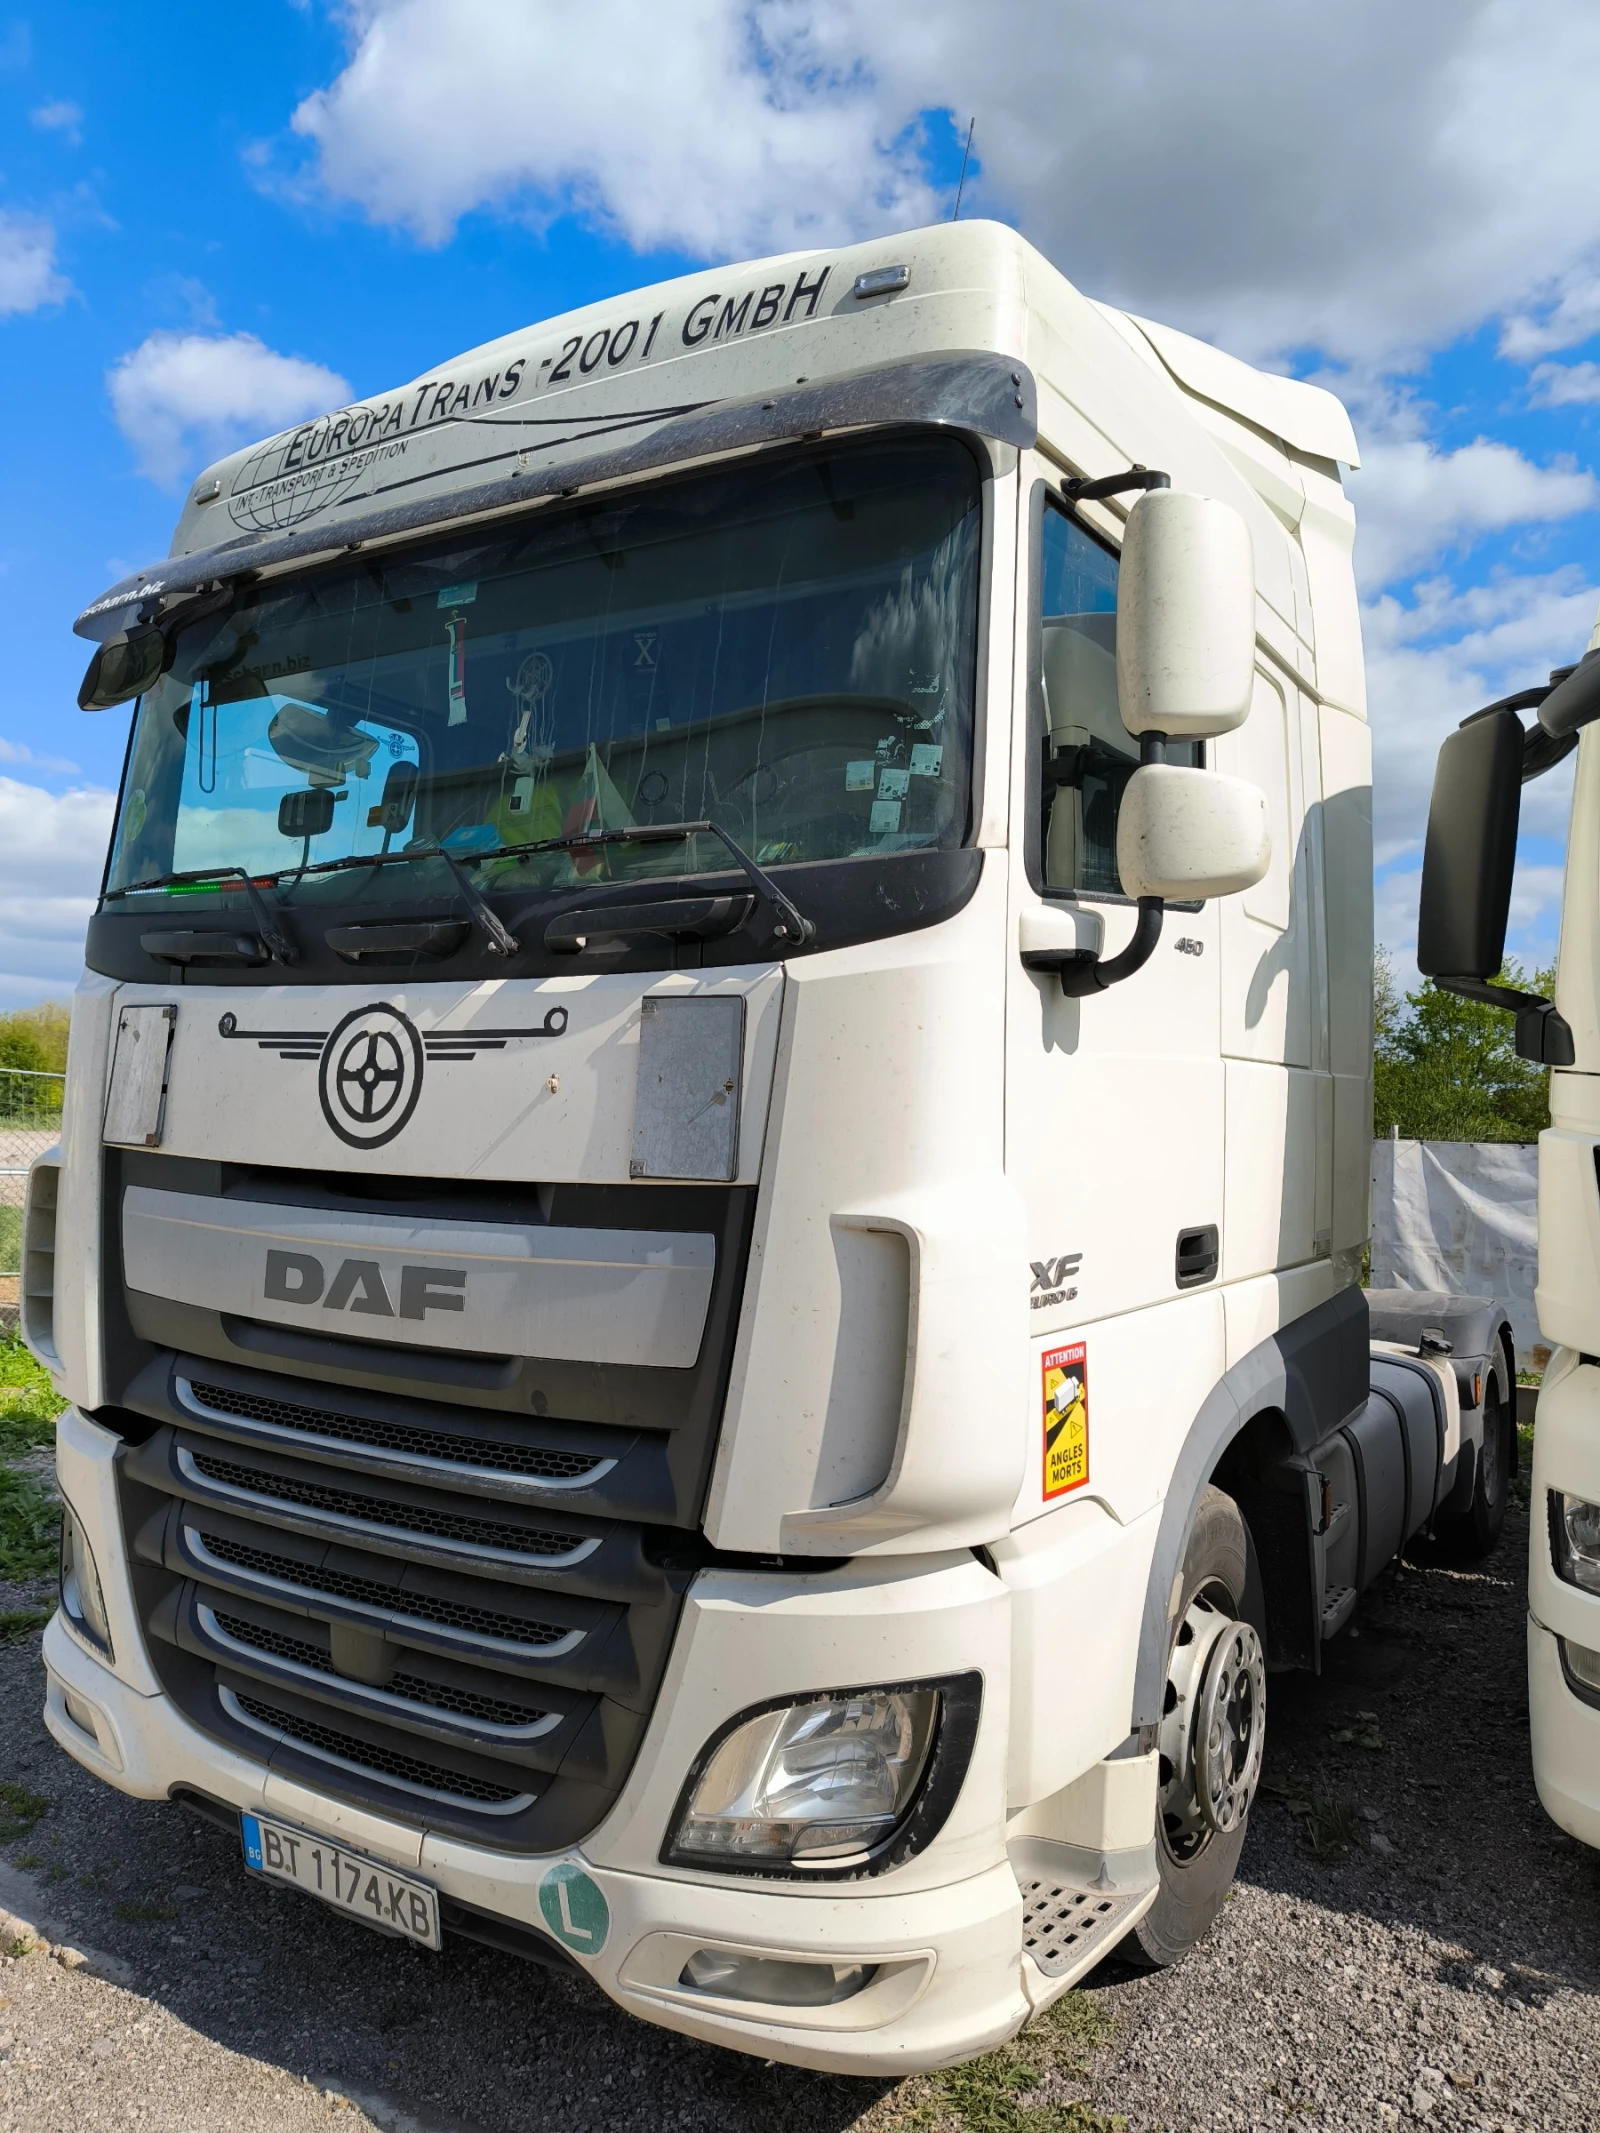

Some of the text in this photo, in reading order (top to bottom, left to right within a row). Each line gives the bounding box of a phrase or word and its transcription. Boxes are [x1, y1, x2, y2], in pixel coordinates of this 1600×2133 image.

[327, 468, 336, 478] &
[339, 440, 409, 475] SPEDITION
[264, 1249, 467, 1320] DAF
[1030, 1253, 1083, 1293] XF
[1045, 1346, 1085, 1368] ATTENTION
[1050, 1443, 1083, 1468] ANGLES
[1052, 1460, 1082, 1484] MORTS
[248, 1846, 261, 1861] BG
[557, 1881, 592, 1940] L
